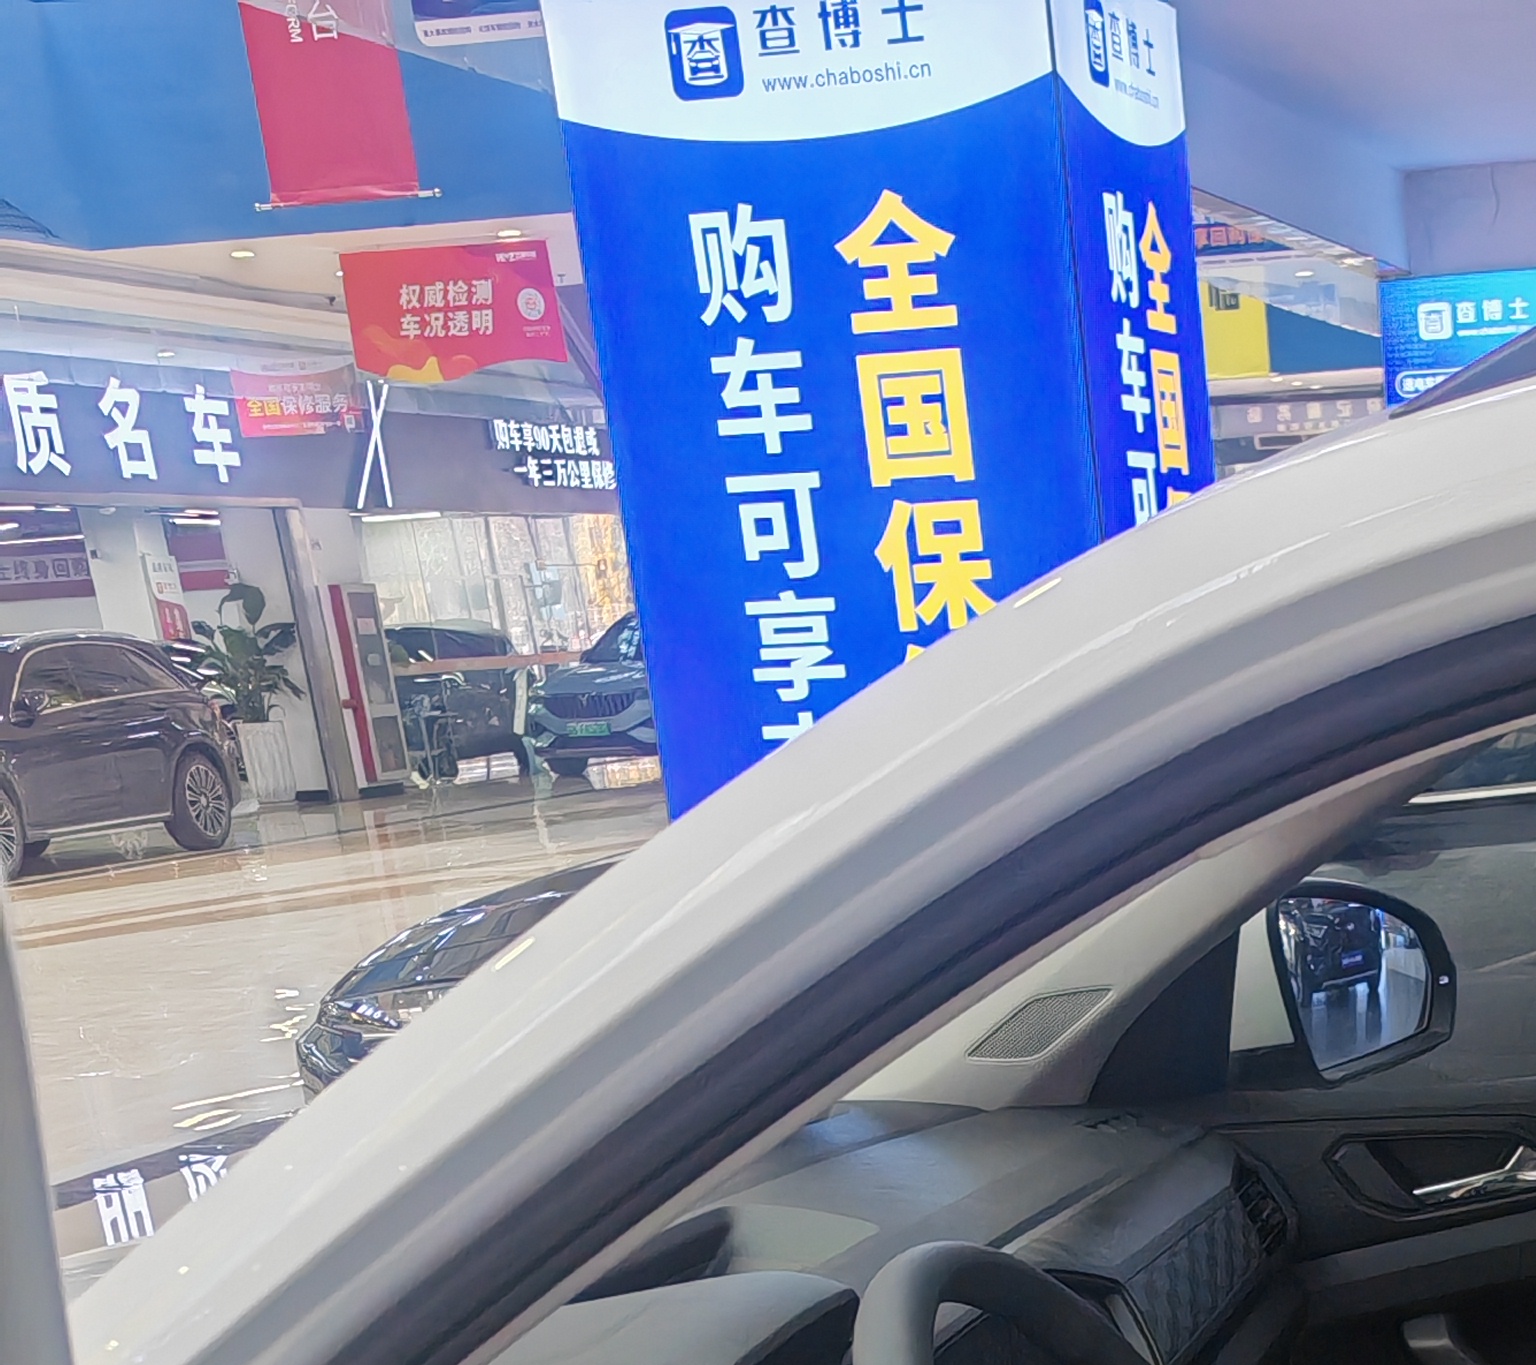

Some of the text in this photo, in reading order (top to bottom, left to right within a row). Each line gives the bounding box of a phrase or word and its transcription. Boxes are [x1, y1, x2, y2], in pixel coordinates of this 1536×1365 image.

[753, 0, 925, 57] 查博士
[1108, 11, 1156, 77] 查博士
[762, 59, 932, 93] www.chaboshi.cn
[399, 279, 493, 310] 权威检测
[399, 309, 494, 340] 车况透明
[1139, 200, 1192, 508] 全国
[3, 371, 241, 483] 质名车
[247, 394, 349, 418] 全国保修服务
[834, 189, 996, 661] 全国保
[493, 418, 600, 457] 购车享90天包退或
[688, 203, 847, 742] 购车可享
